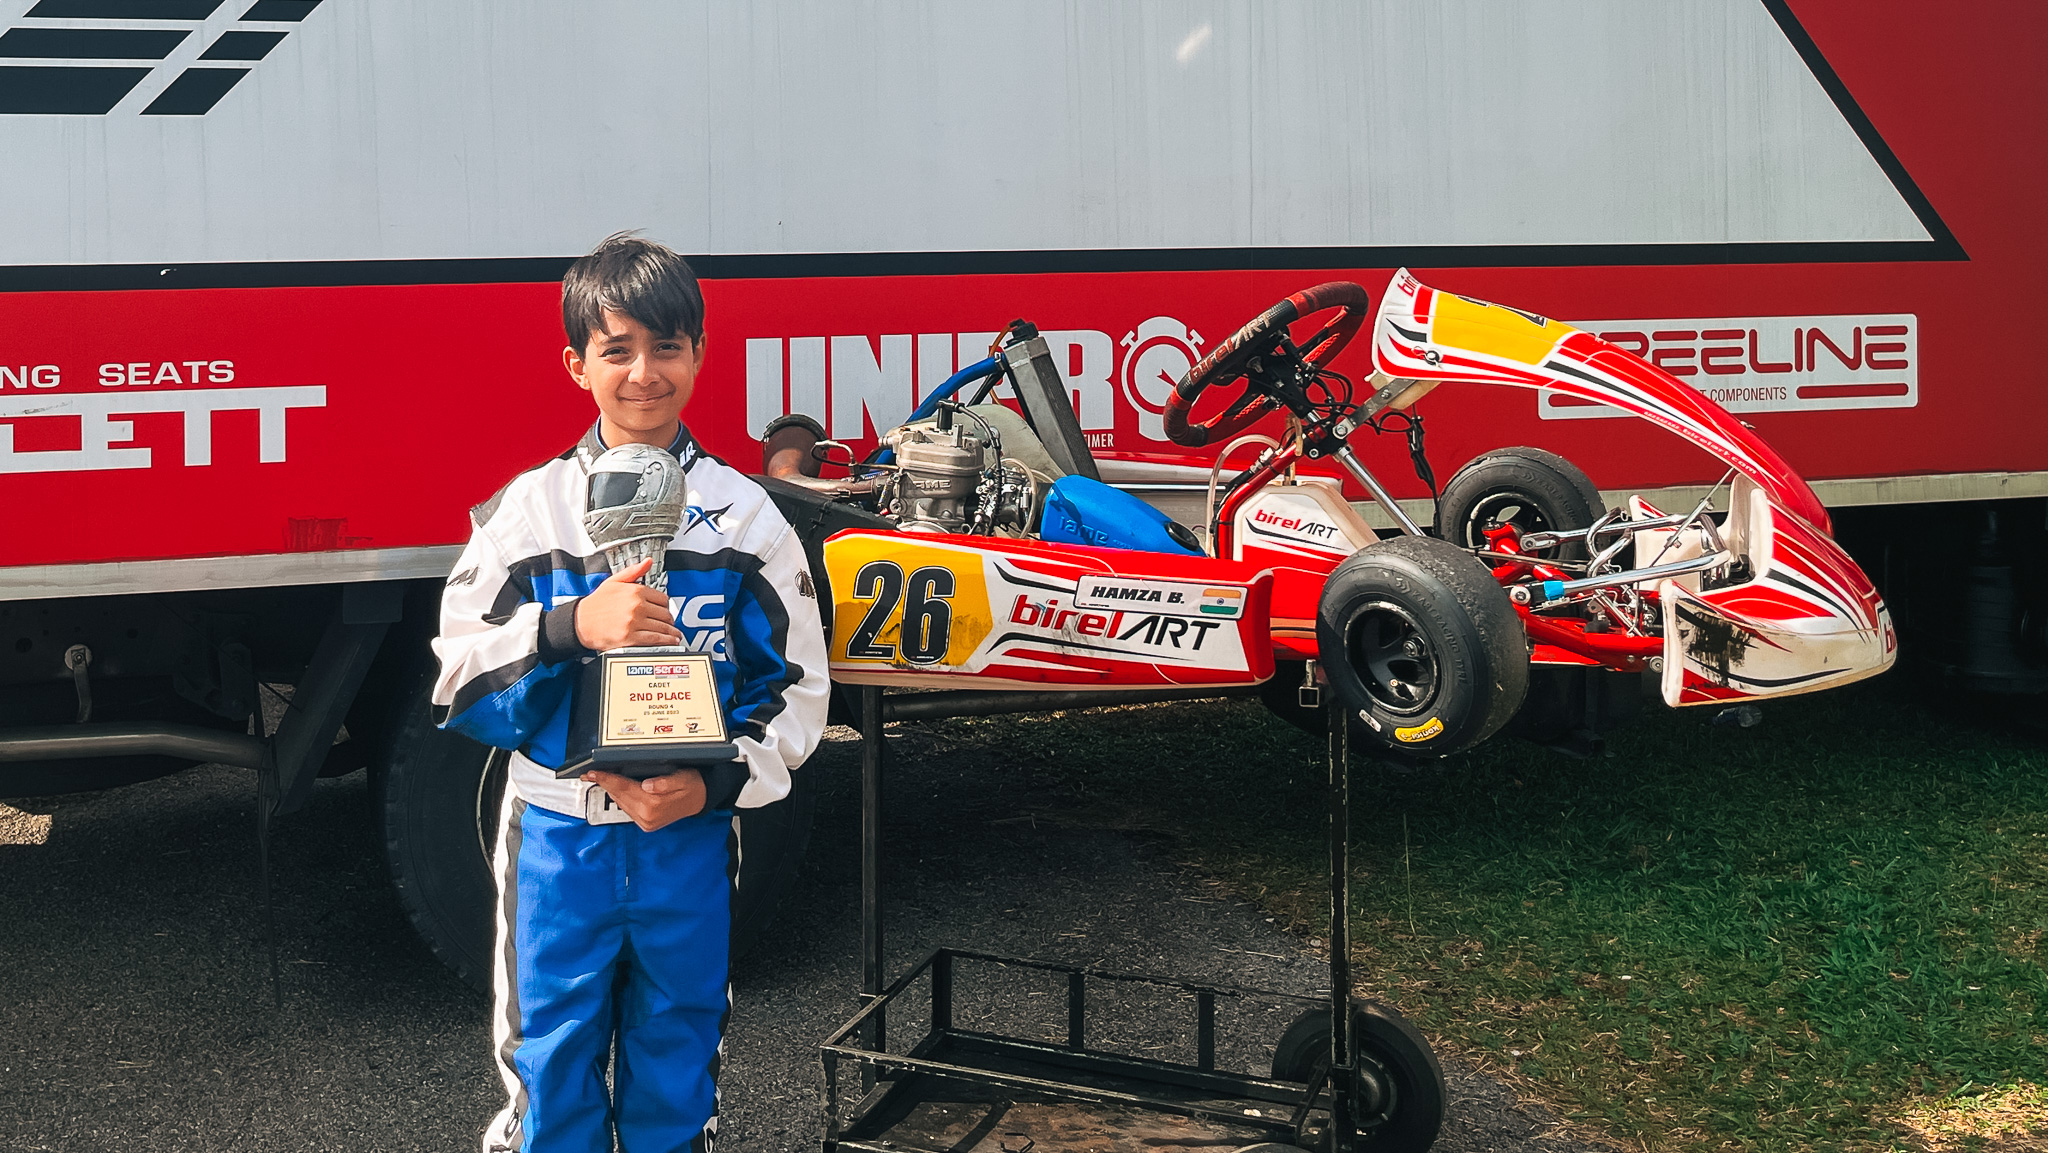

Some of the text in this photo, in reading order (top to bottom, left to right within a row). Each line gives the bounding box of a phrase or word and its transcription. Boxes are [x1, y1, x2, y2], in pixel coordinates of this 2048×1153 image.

[1588, 326, 1908, 376] REELINE
[98, 360, 235, 386] SEATS
[1710, 386, 1787, 402] COMPONENTS
[1254, 509, 1339, 539] birelART
[1090, 586, 1186, 605] HAMZA B.
[846, 560, 956, 665] 26
[1009, 594, 1221, 650] birelART
[655, 665, 689, 675] series
[629, 691, 692, 702] 2ND PLACE
